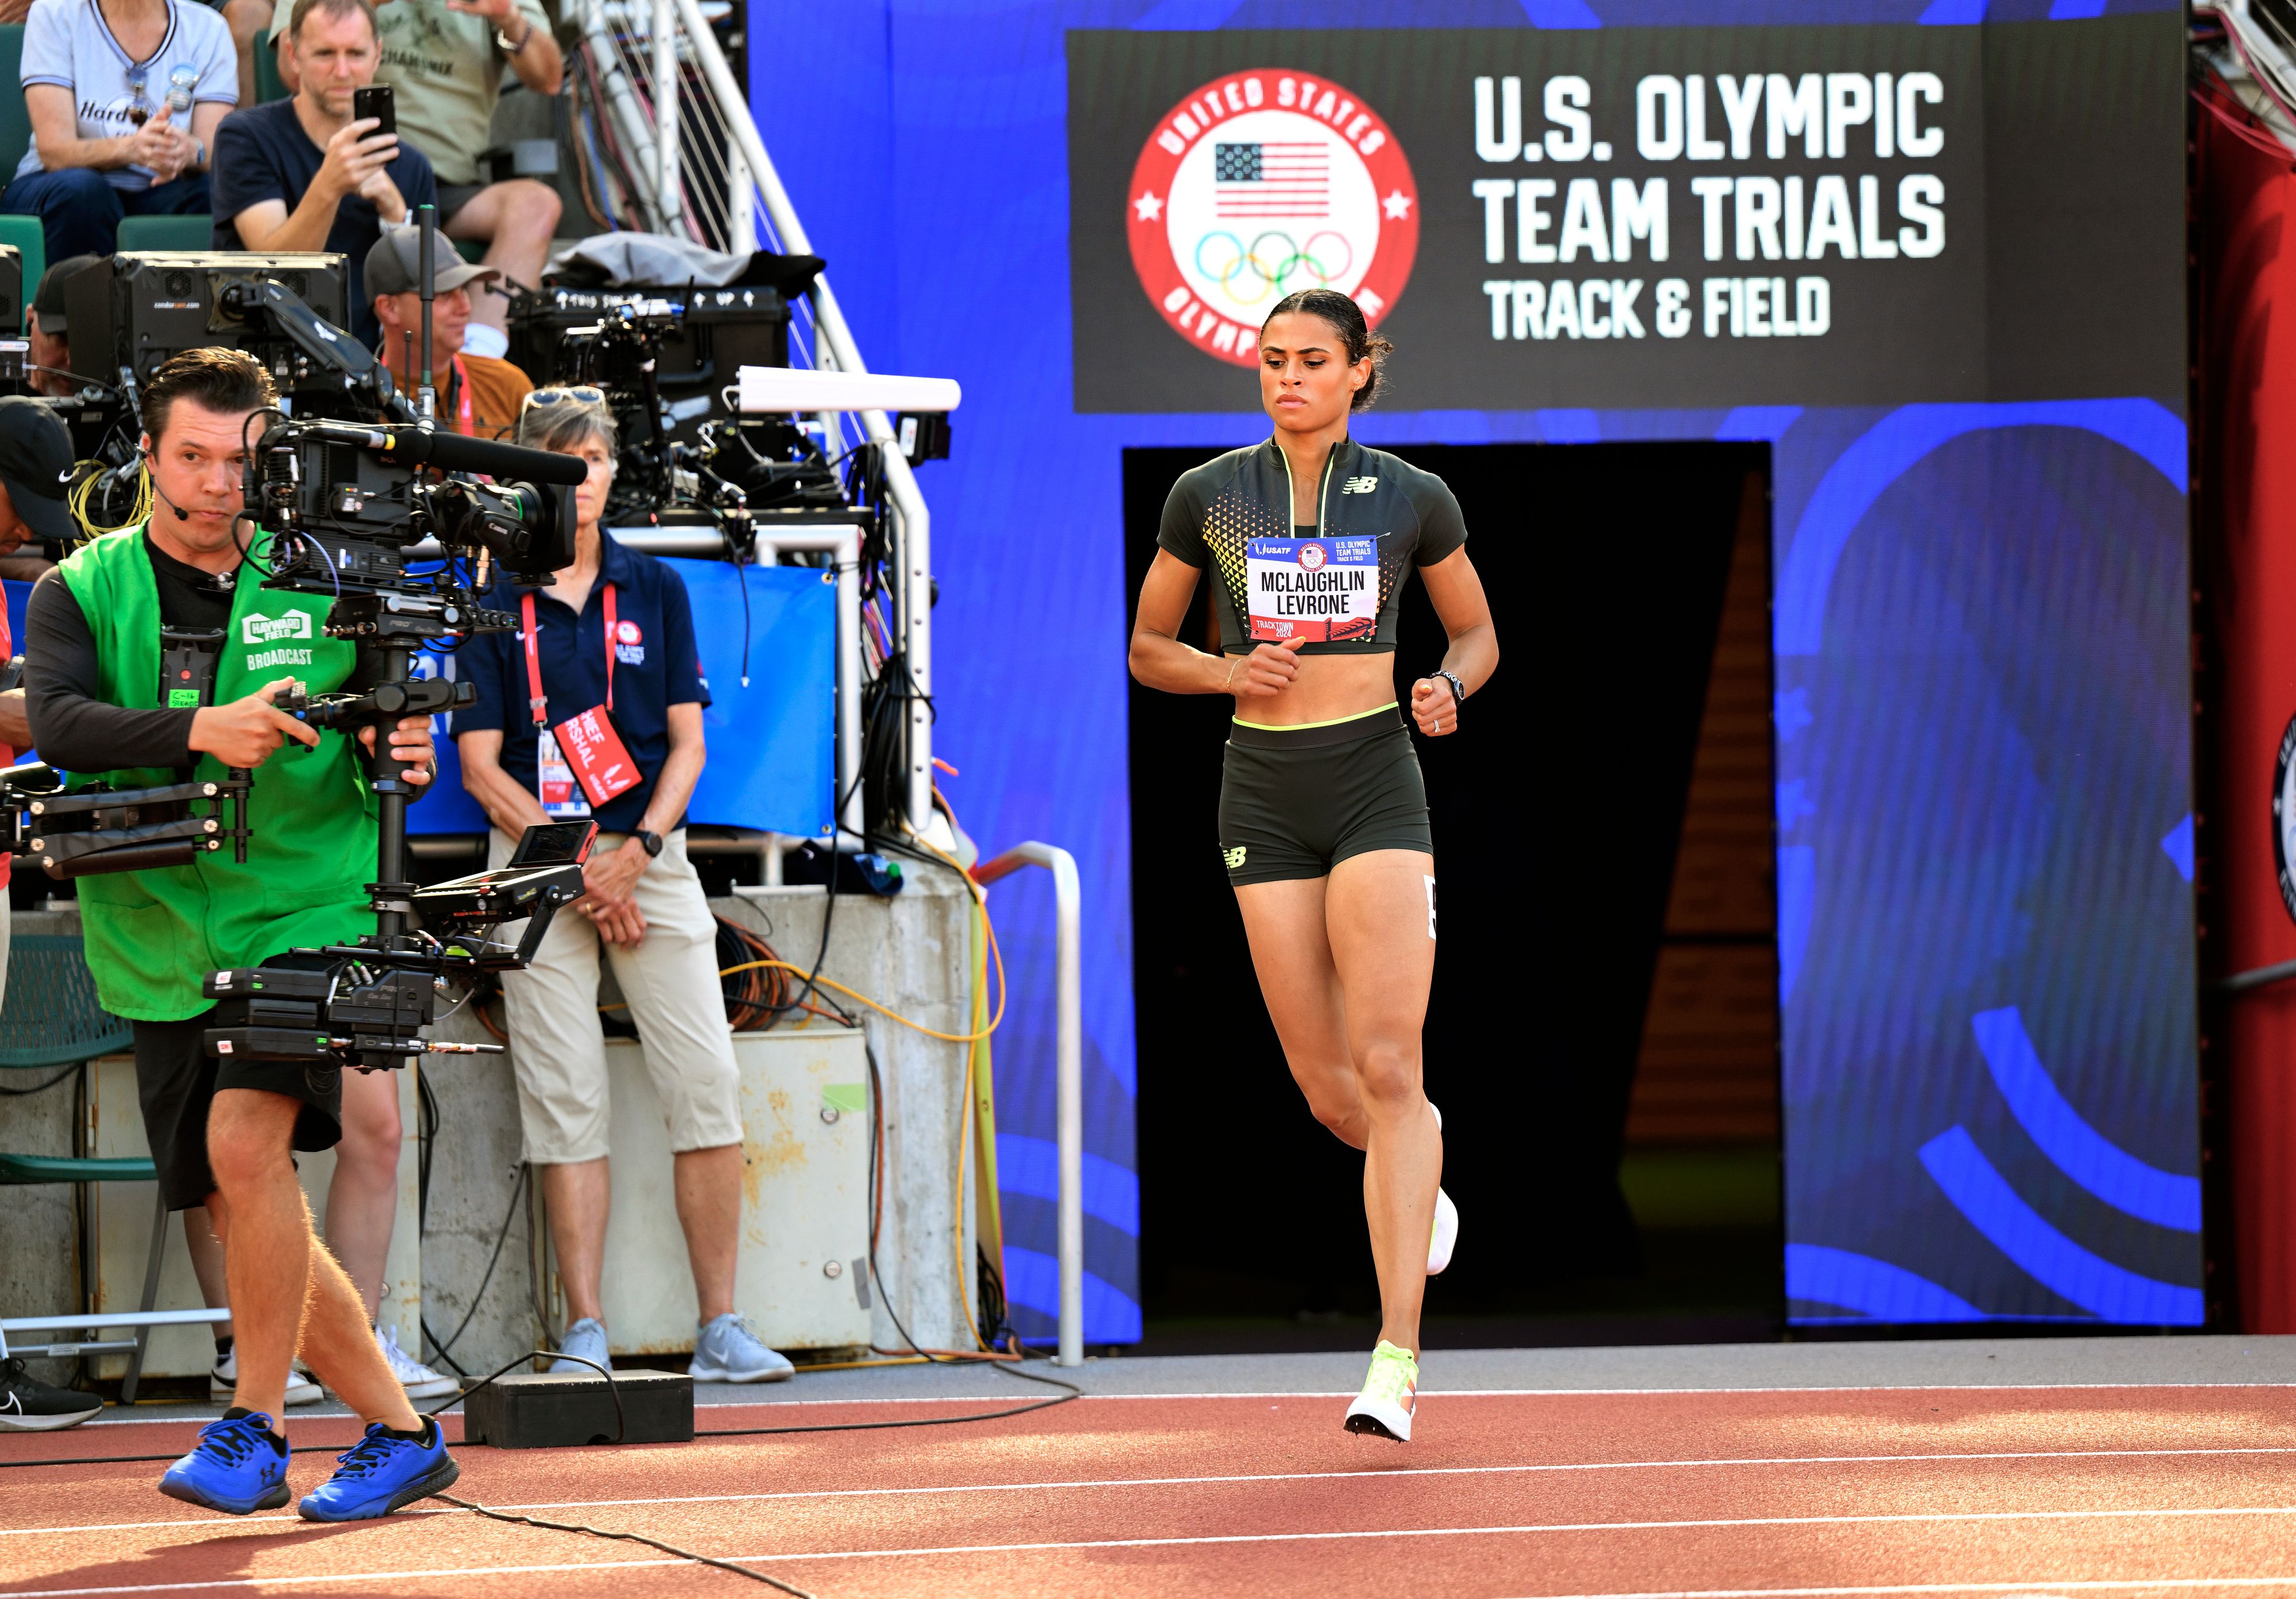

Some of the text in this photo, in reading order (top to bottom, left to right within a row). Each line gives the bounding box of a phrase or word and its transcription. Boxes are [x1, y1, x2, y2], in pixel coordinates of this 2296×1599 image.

[79, 100, 130, 122] Hard
[1157, 77, 1386, 156] UNITED STATES
[1475, 72, 1944, 162] U.S. OLYMPIC
[1472, 174, 1945, 264] TEAM TRIALS
[716, 291, 735, 305] UP
[1483, 276, 1831, 341] TRACK & FIELD
[1163, 286, 1261, 357] OLYMP
[1348, 540, 1370, 548] OLYMPIC
[1352, 548, 1371, 556] TRIALS
[1262, 571, 1364, 593] MCLAUGHLIN
[1277, 594, 1349, 615] LEVRONE
[251, 618, 300, 634] HAYWARD
[264, 629, 291, 641] FIELD
[1256, 620, 1294, 630] TRACKTOWN
[1276, 629, 1292, 638] 2024
[247, 649, 312, 671] BROADCAST
[173, 691, 195, 699] C-16
